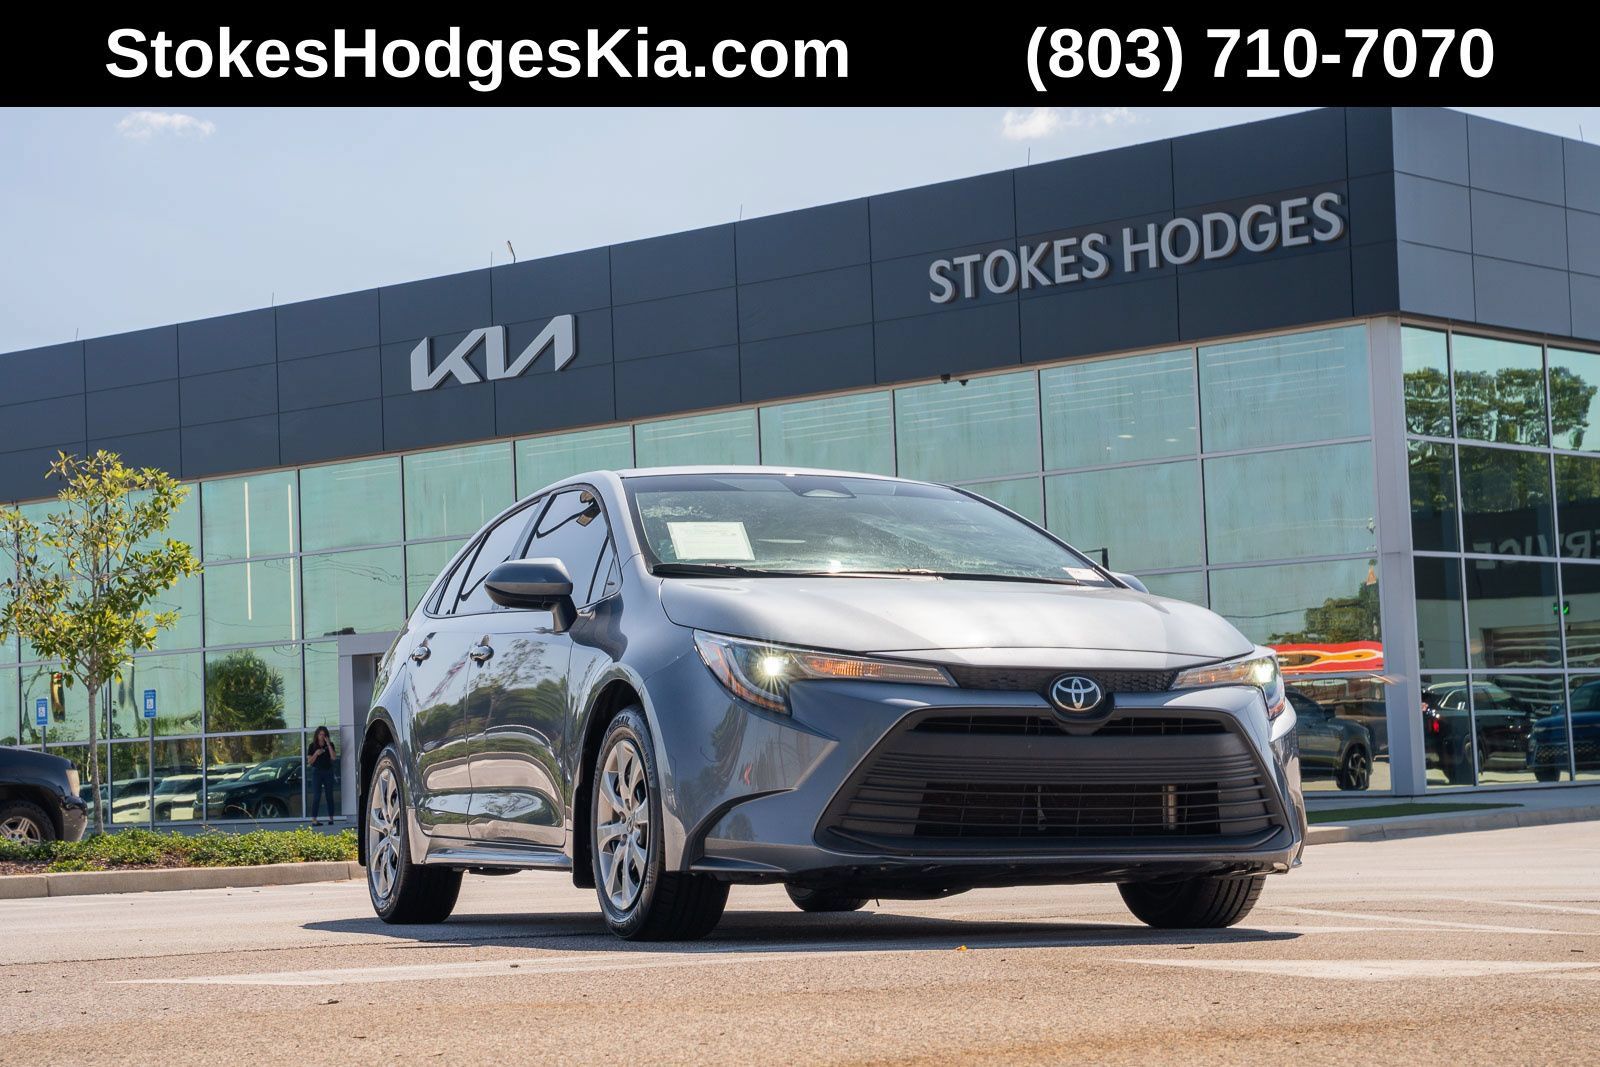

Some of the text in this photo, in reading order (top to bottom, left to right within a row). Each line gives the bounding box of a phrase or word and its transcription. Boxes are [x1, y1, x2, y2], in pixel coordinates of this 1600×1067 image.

[928, 192, 1346, 304] STOKES HODGES
[410, 314, 576, 392] KIA
